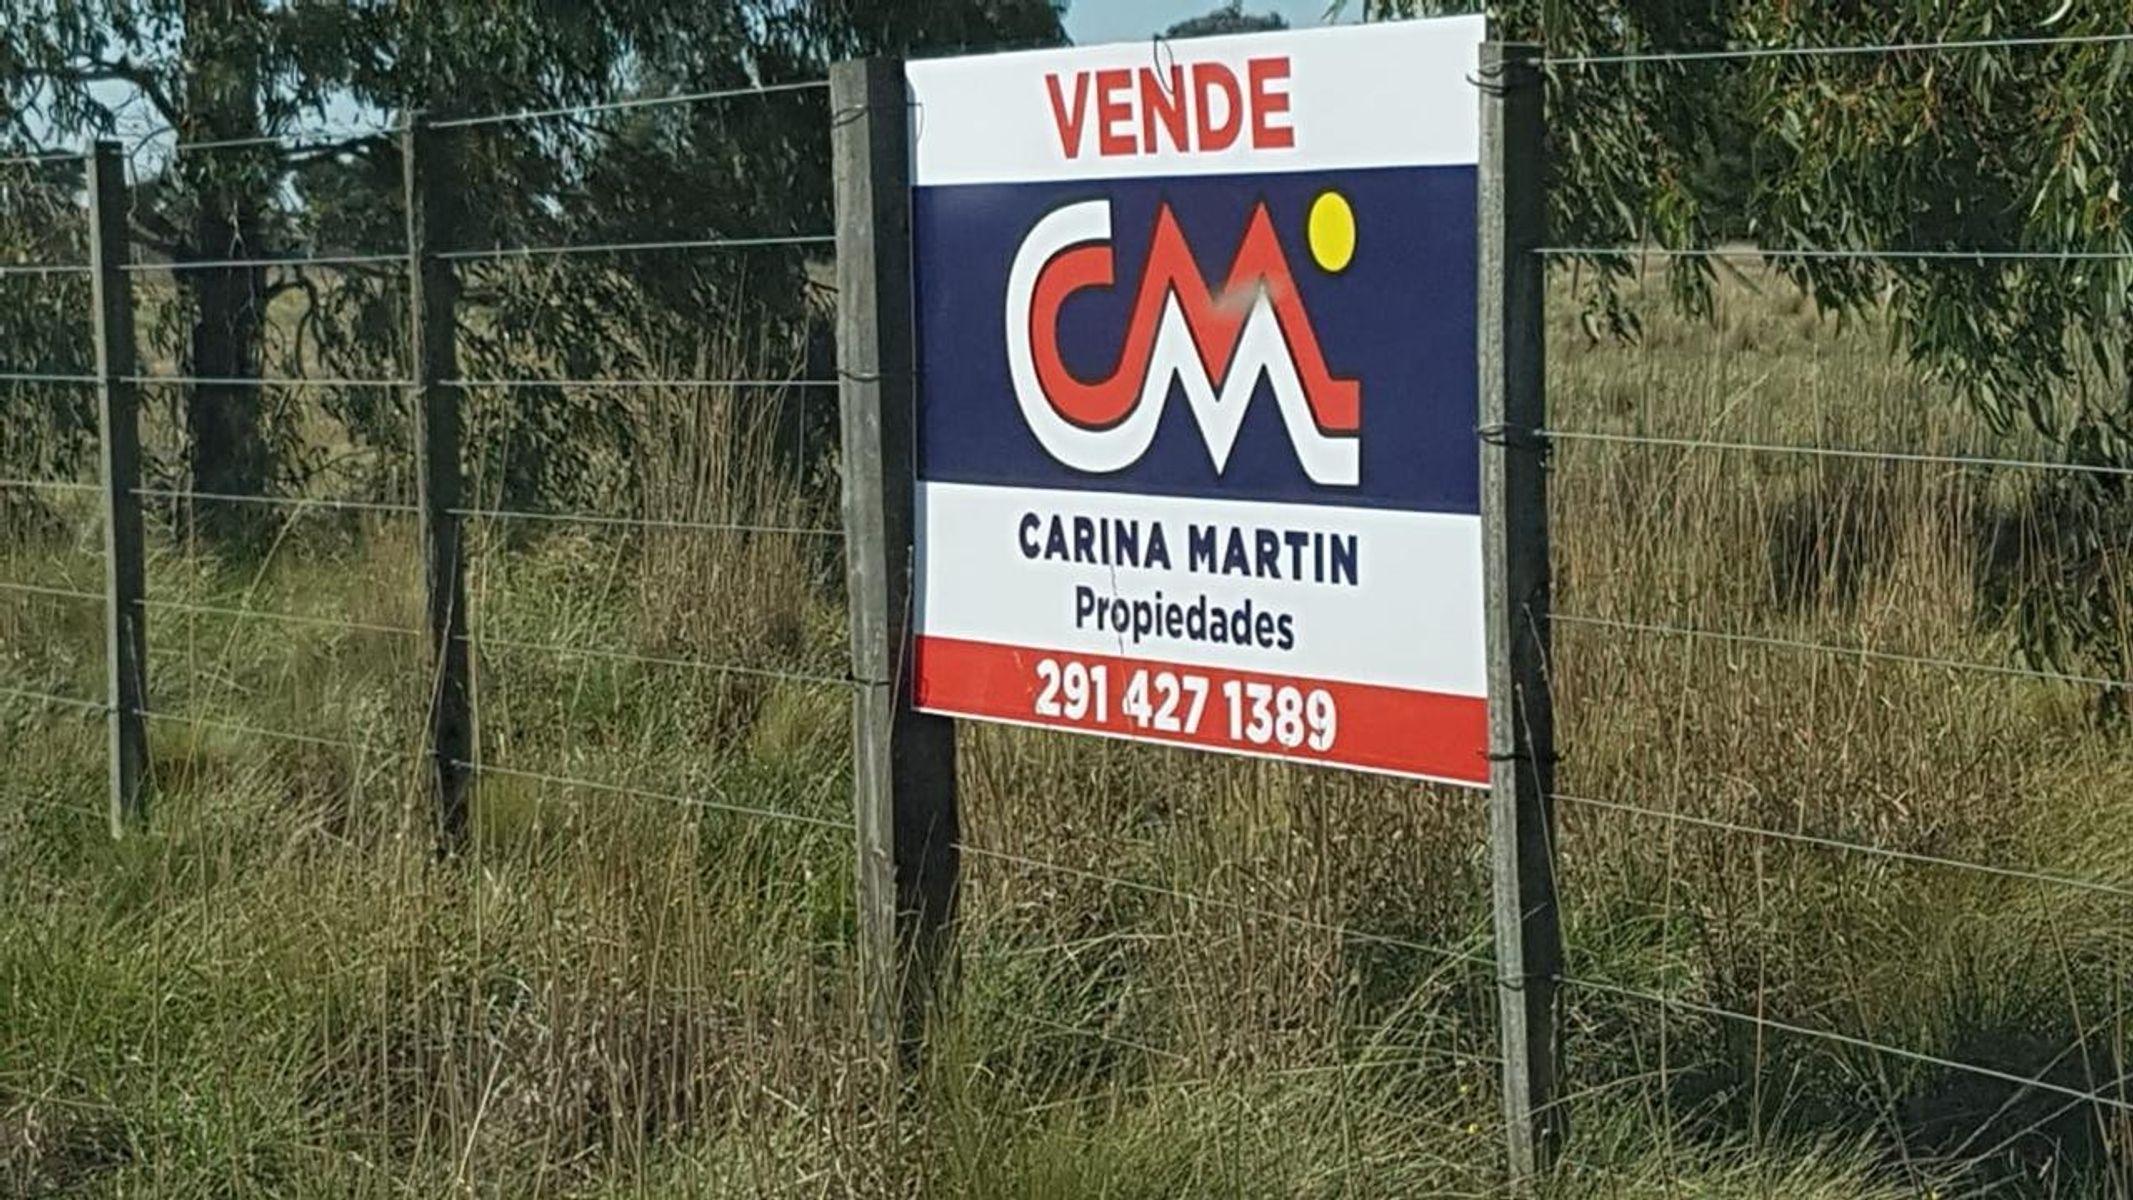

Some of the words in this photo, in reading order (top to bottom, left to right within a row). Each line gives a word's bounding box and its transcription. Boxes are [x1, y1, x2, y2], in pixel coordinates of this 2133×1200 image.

[1045, 56, 1295, 159] VENDE
[1018, 511, 1171, 571] CARINA
[1188, 524, 1359, 586] MARTIN
[1075, 584, 1295, 651] Propiedades
[1034, 658, 1108, 723] 291
[1121, 669, 1210, 735] 427
[1222, 680, 1337, 752] 1389
